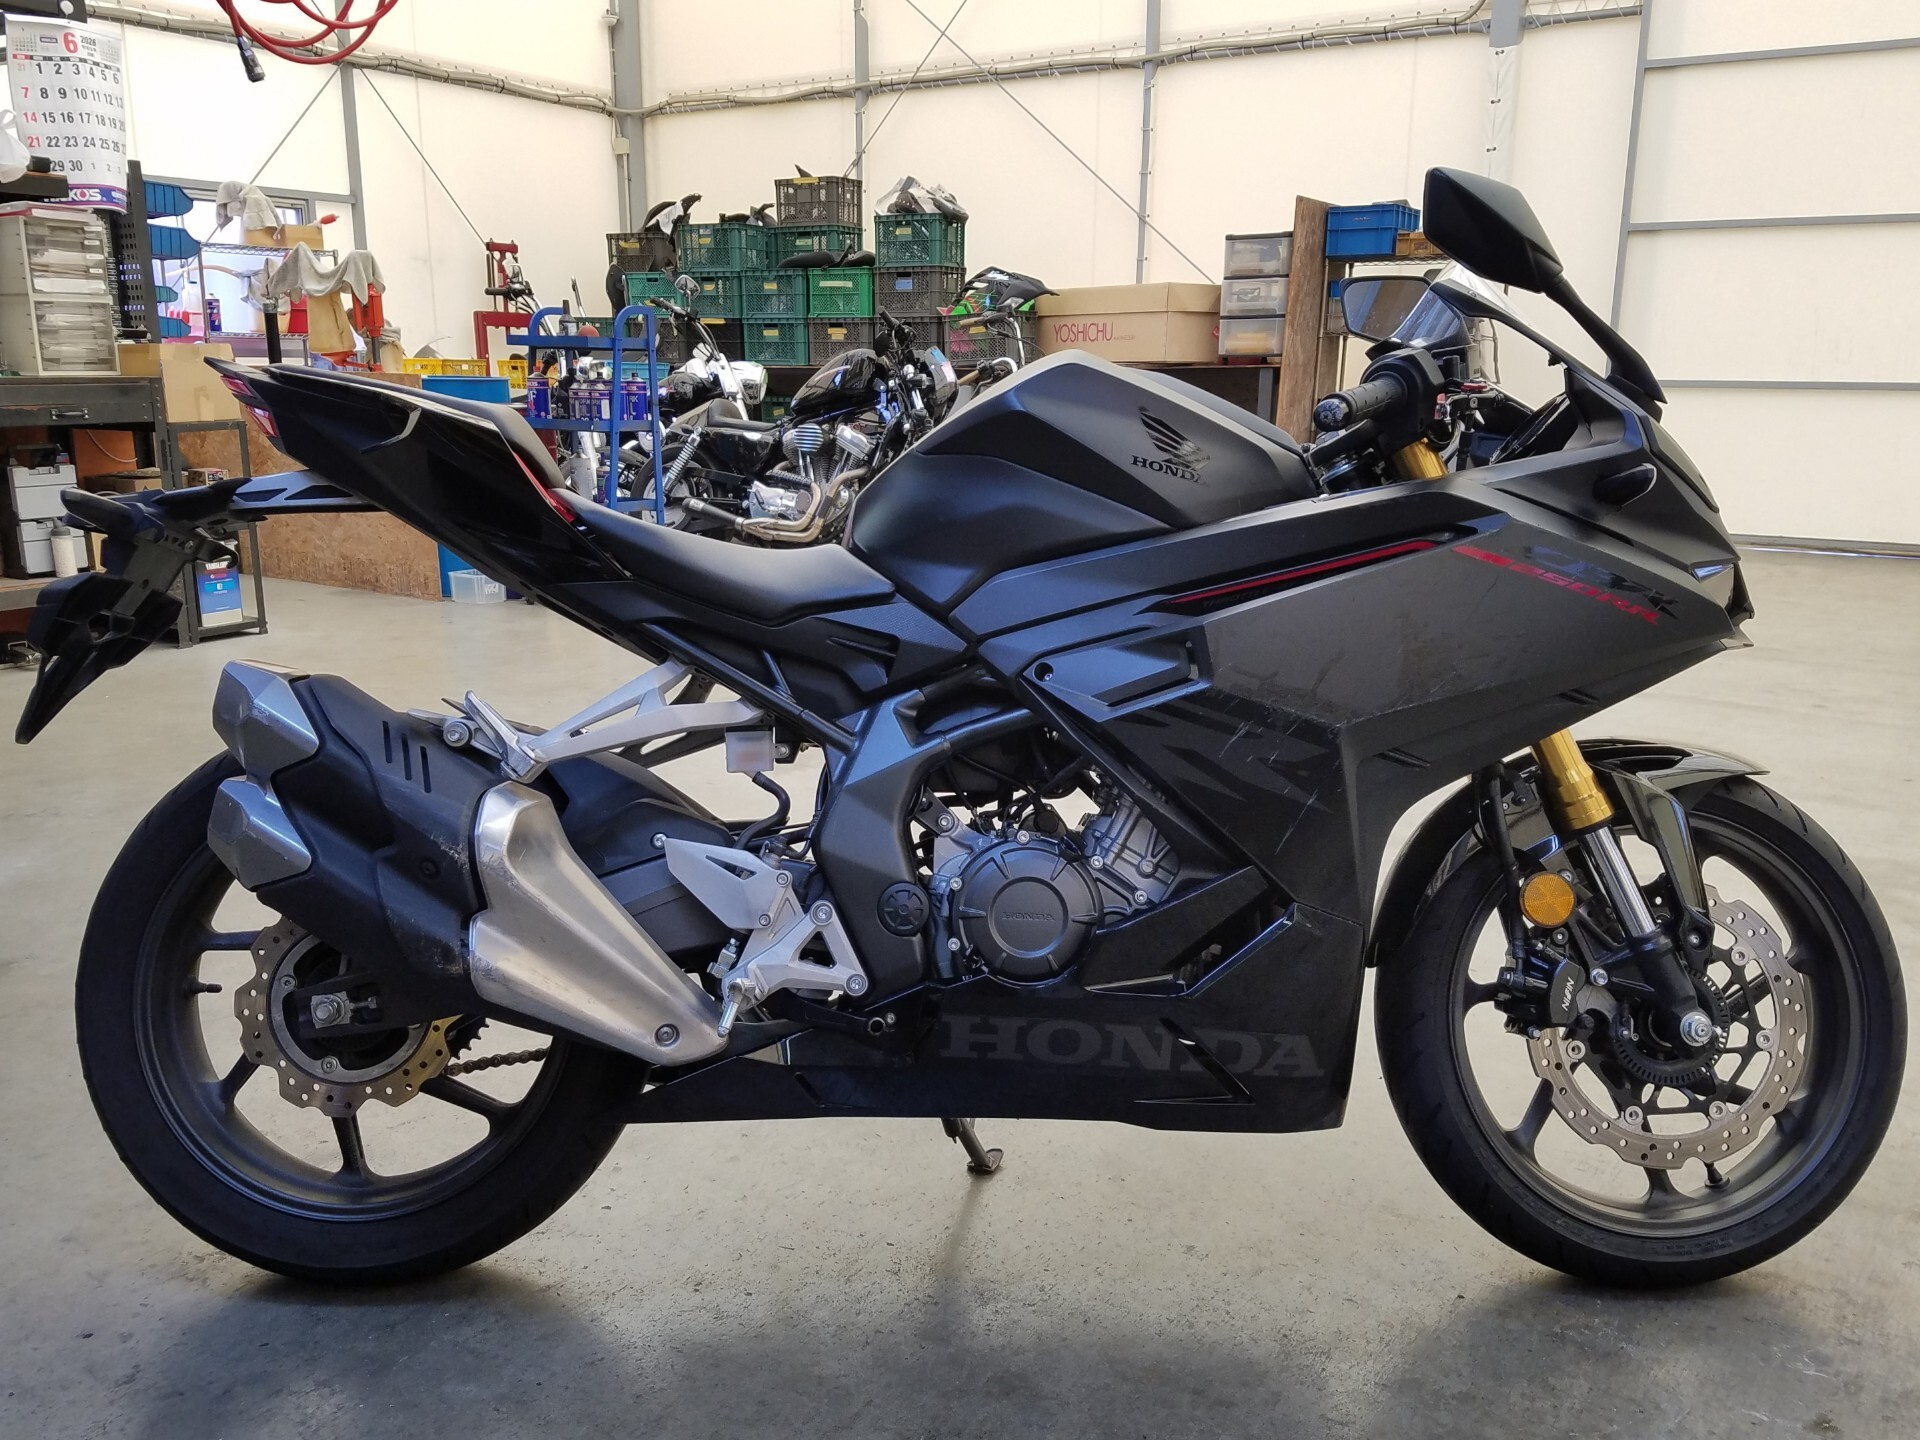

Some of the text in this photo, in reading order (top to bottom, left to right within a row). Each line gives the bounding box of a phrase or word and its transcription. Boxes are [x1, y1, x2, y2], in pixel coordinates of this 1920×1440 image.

[63, 31, 79, 54] 6
[79, 35, 97, 47] 2026
[35, 62, 43, 75] 1
[53, 62, 63, 75] 2
[71, 63, 81, 76] 3
[88, 66, 96, 78] 4
[100, 69, 108, 82] 5
[112, 72, 120, 85] 6
[20, 86, 30, 99] 7
[39, 87, 49, 100] 8
[57, 87, 68, 100] 9
[73, 87, 88, 100] 10
[90, 89, 101, 103] 11
[103, 93, 114, 106] 12
[23, 111, 38, 124] 14
[41, 111, 56, 124] 15
[59, 111, 75, 124] 16
[78, 112, 91, 124] 17
[95, 114, 106, 127] 18
[107, 116, 117, 130] 19
[27, 135, 41, 148] 21
[45, 135, 61, 148] 22
[63, 135, 79, 148] 23
[81, 136, 97, 148] 24
[98, 137, 110, 150] 25
[111, 140, 120, 153] 26
[51, 159, 65, 172] 29
[68, 159, 83, 172] 30
[1053, 321, 1114, 344] YOSHICHU
[1130, 454, 1211, 487] HONDA
[1001, 911, 1057, 922] HONDA
[939, 1013, 1326, 1078] HONDA
